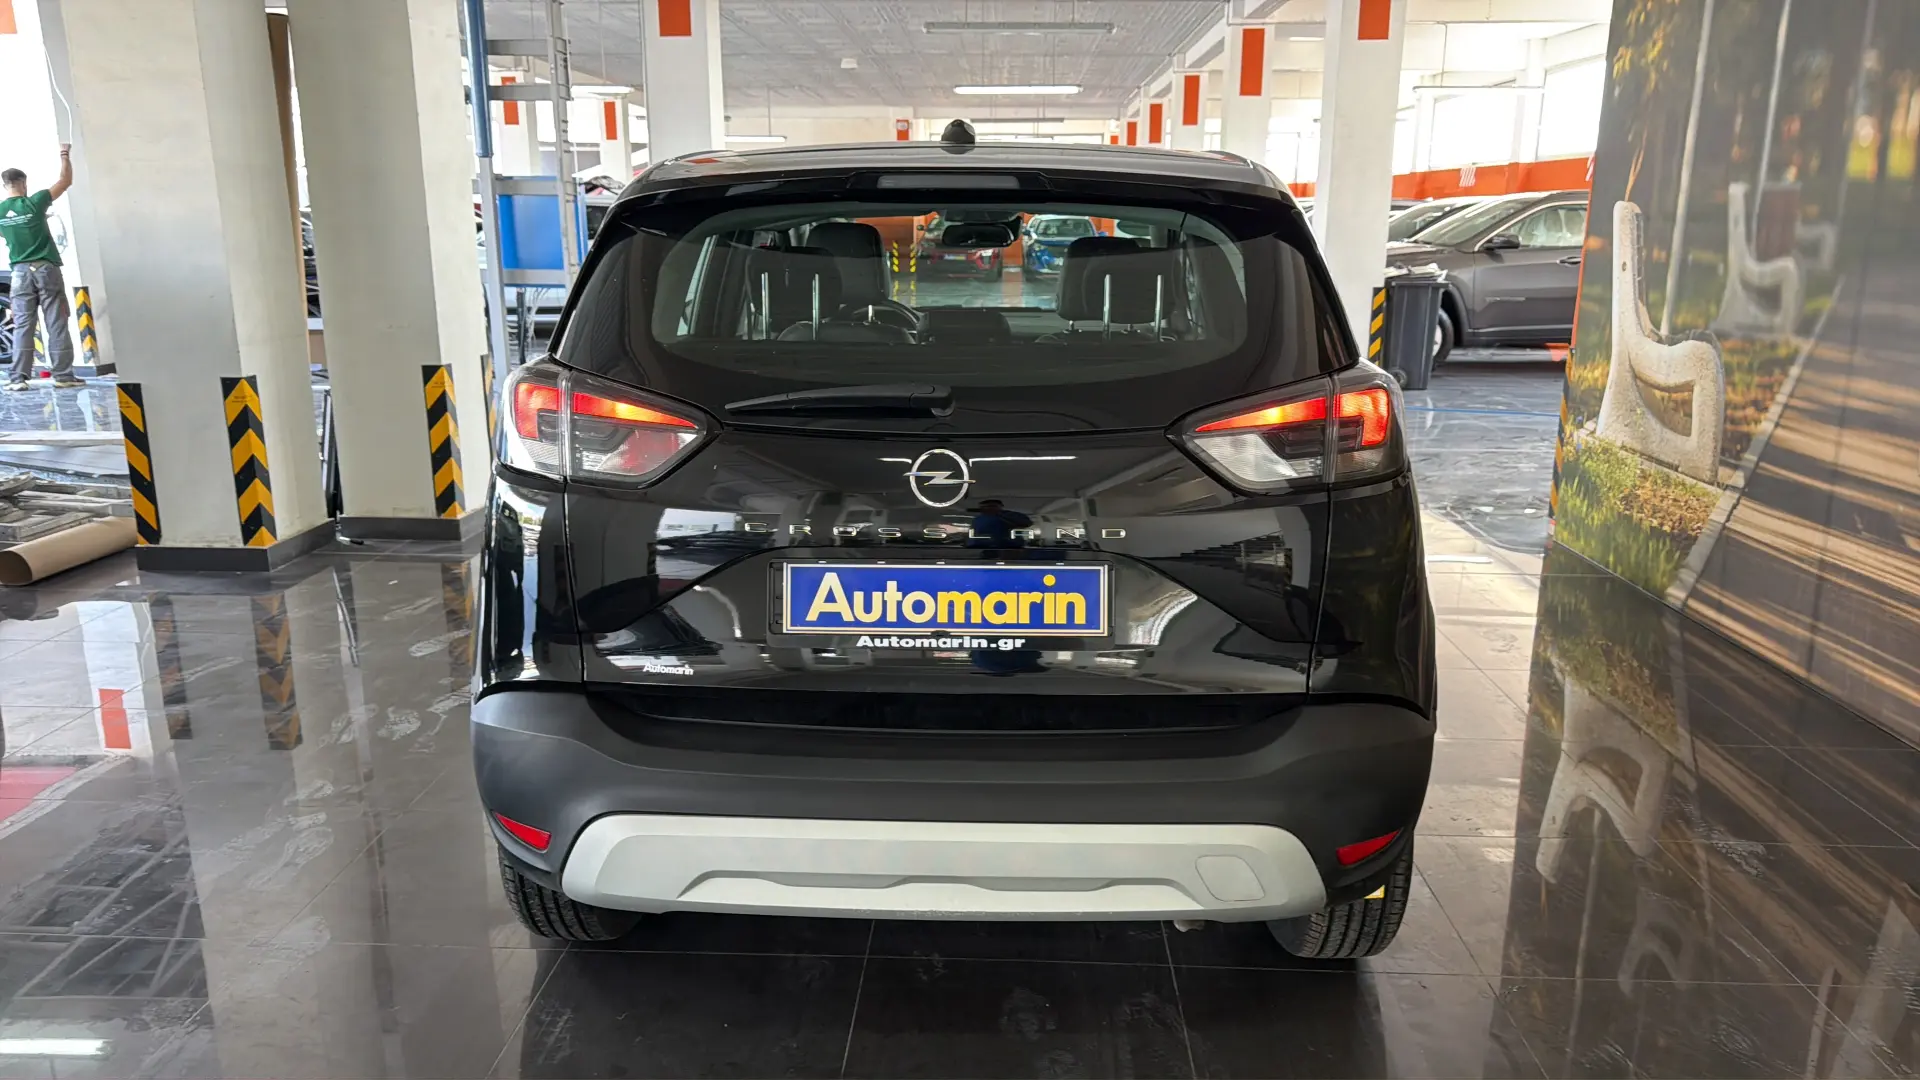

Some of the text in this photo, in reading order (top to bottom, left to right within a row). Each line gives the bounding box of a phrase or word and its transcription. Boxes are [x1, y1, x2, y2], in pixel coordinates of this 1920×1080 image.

[744, 522, 1127, 540] CROSSLAND
[805, 572, 1087, 625] Automarin
[856, 635, 1026, 651] Automarin.gr
[642, 662, 695, 676] Automarin
